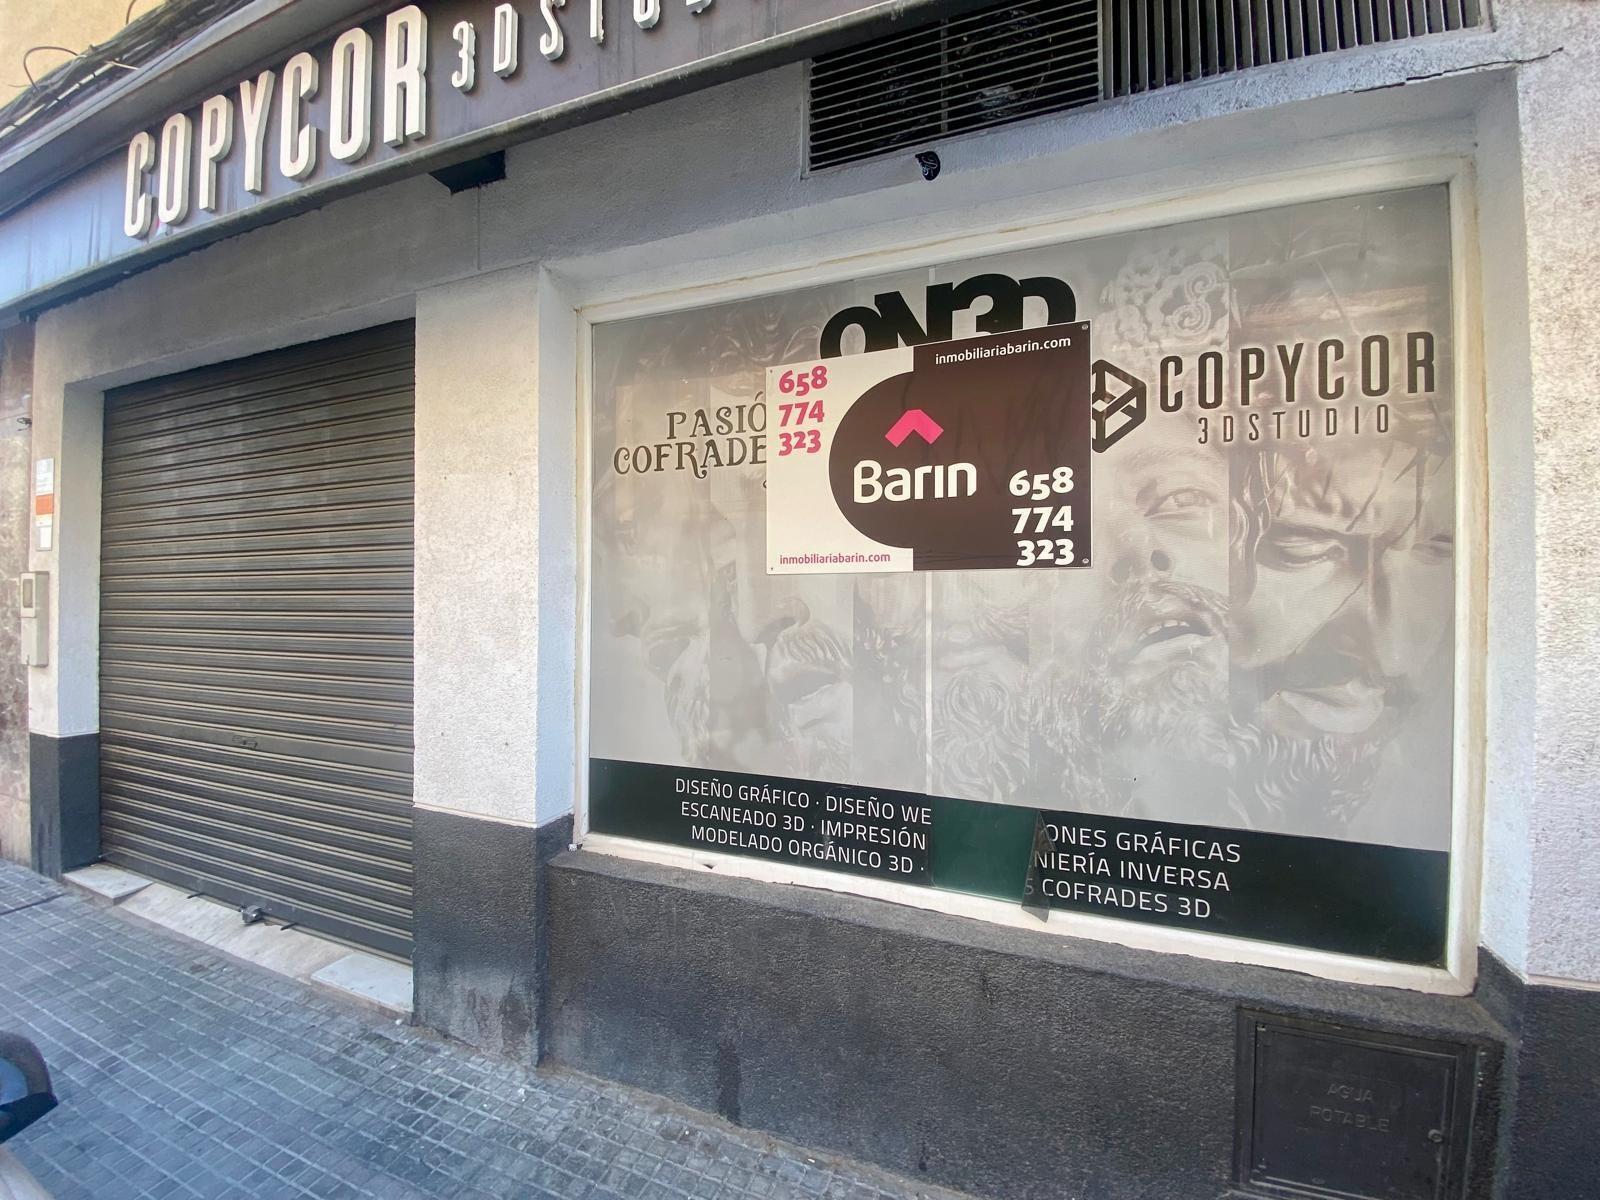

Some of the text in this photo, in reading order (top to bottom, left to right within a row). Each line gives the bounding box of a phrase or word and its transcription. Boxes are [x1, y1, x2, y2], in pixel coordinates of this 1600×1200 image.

[123, 0, 712, 239] COPYCOR 3DS
[935, 335, 1071, 365] inmobiliariabarin.com
[778, 365, 829, 397] 658
[1159, 331, 1436, 413] COPYCOR
[778, 399, 826, 427] 774
[1198, 403, 1390, 445] 3DSTUDIO
[613, 434, 767, 479] COFRADE
[778, 429, 822, 456] 323
[1008, 466, 1075, 500] 658
[1011, 505, 1075, 534] 774
[779, 551, 891, 566] inmobiliariabarin.com
[1015, 538, 1075, 567] 323
[675, 778, 933, 825] DISEÑO GRÁFICO DISEÑO WE
[681, 801, 927, 851] ESCANEADO 3D IMPRESIÓN
[691, 825, 914, 874] MODELADO ORGÁNICO 3D
[1116, 831, 1242, 864] GRÁFICAS
[1120, 860, 1231, 892] INVERSA
[1042, 878, 1169, 913] COFRADES
[1178, 896, 1211, 919] 3D
[1326, 1083, 1375, 1104] AGUA
[1310, 1105, 1390, 1133] POTABLE
